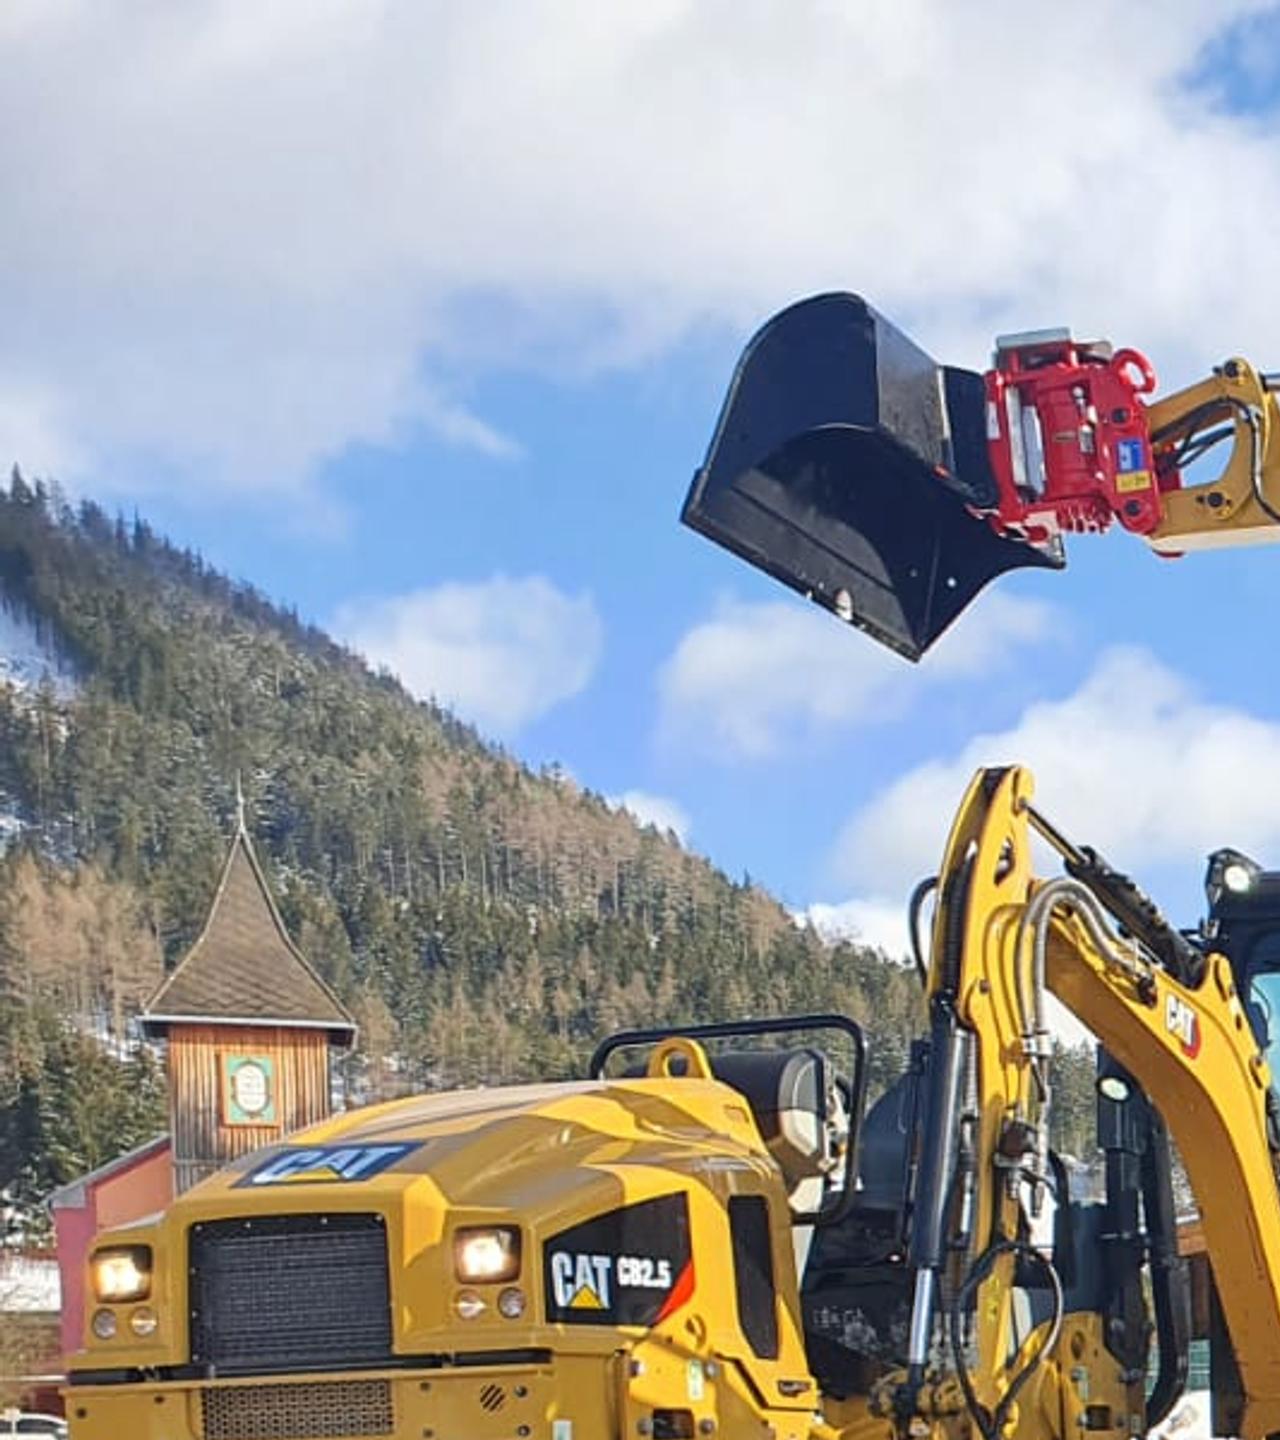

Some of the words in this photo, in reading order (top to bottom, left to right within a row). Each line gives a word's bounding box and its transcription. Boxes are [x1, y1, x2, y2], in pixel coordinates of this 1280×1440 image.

[252, 1146, 406, 1184] CAT
[551, 1251, 612, 1309] CAT
[616, 1256, 672, 1288] CB2.5
